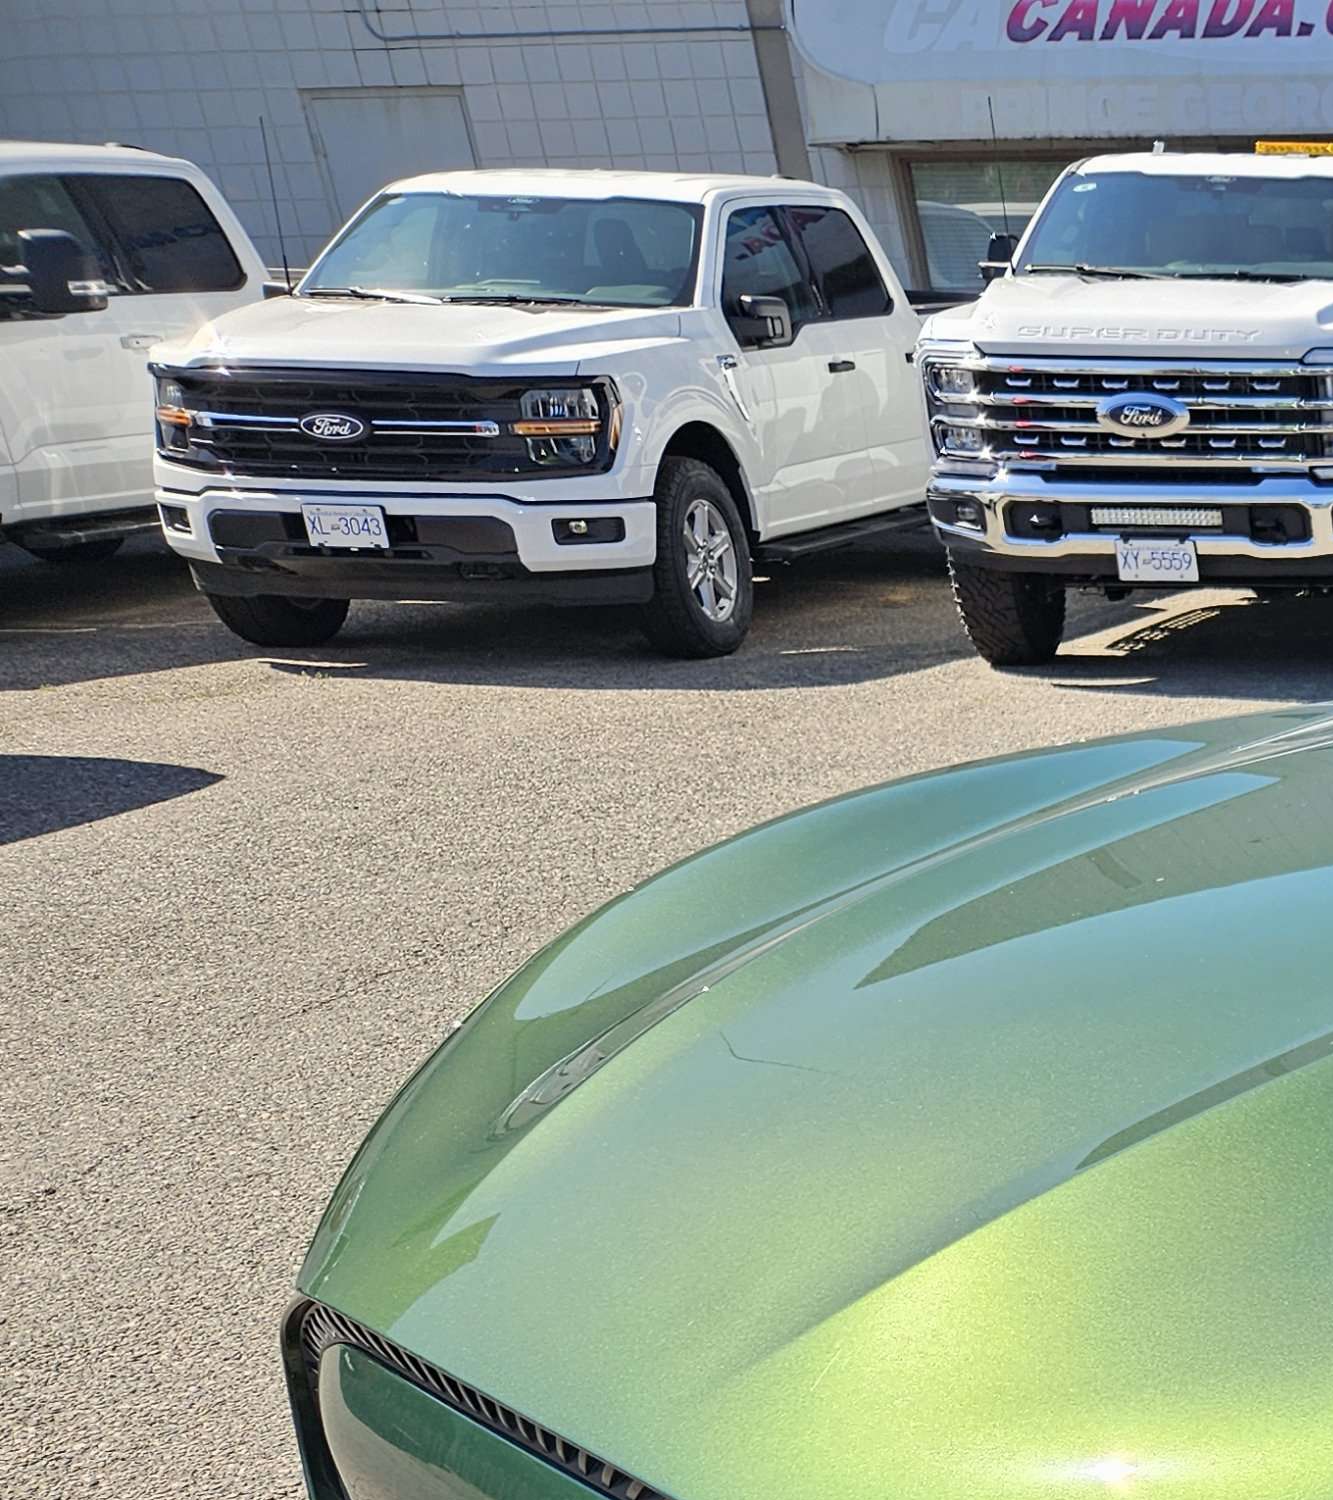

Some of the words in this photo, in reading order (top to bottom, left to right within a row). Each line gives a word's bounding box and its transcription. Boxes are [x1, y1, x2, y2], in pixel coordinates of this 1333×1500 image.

[1017, 325, 1149, 341] SUPER
[1155, 327, 1263, 342] DUTY
[1119, 404, 1163, 427] Ford
[312, 416, 352, 436] Ford
